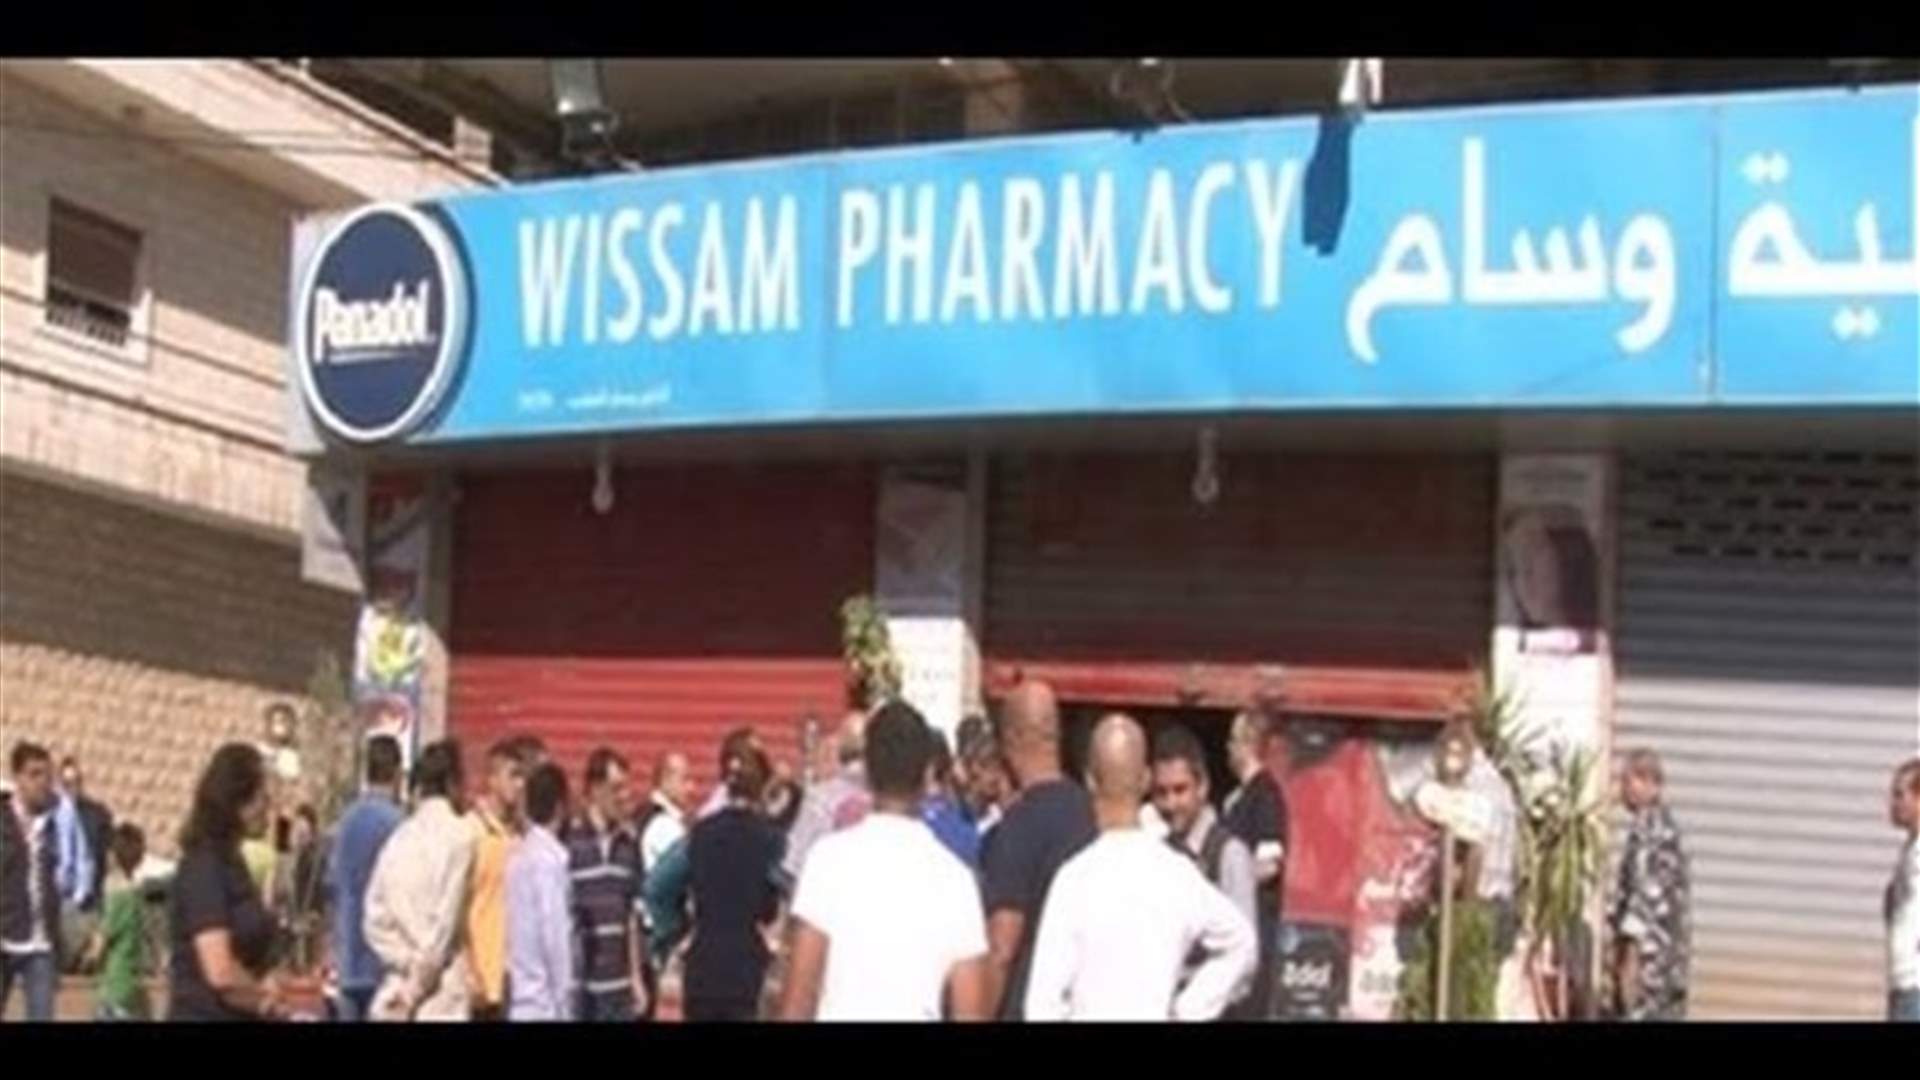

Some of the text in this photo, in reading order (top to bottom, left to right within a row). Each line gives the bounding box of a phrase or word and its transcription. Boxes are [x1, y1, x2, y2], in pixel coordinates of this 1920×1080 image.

[313, 279, 431, 363] Panadol
[518, 158, 1301, 347] WISSAM PHARMACY
[1345, 136, 1677, 363] وسام
